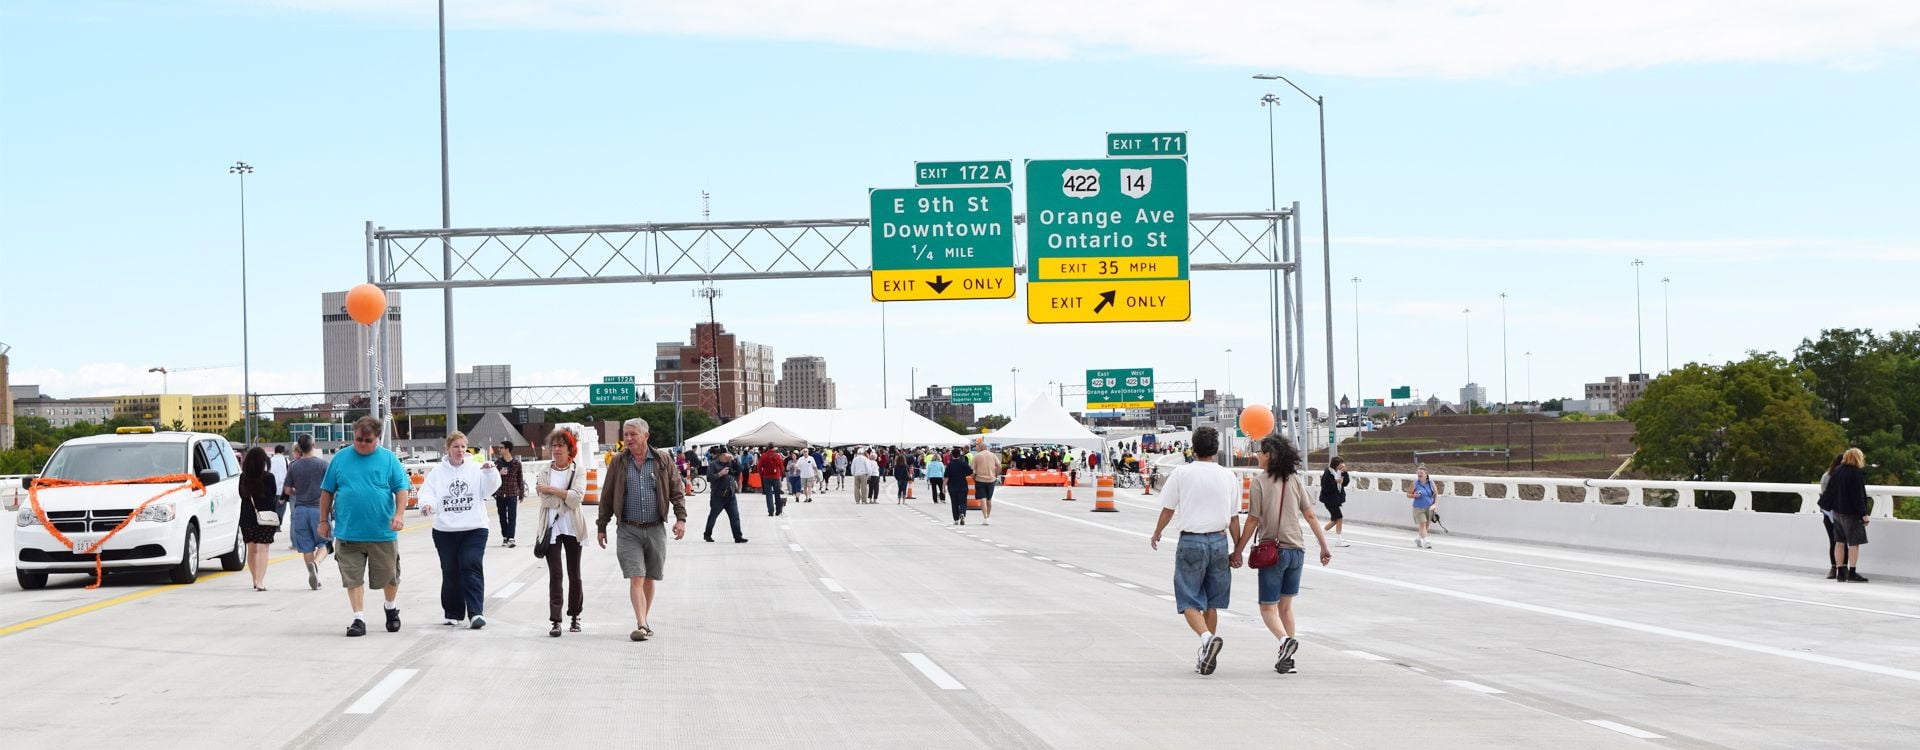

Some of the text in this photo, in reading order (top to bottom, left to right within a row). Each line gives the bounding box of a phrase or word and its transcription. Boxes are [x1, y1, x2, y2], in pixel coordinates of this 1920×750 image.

[1113, 137, 1182, 151] EXIT 171
[921, 165, 1006, 180] EXIT 172 A
[1064, 174, 1146, 192] 422 14
[894, 197, 989, 214] E 9th St
[1040, 208, 1175, 228] Orange Ave
[883, 222, 1001, 238] Downtown
[1048, 232, 1167, 249] Ontario St
[945, 247, 974, 257] MILE
[1061, 261, 1156, 274] EXIT 35 MPH
[884, 278, 1003, 292] EXIT ONLY
[1052, 296, 1167, 309] EXIT ONLY
[443, 497, 473, 505] KOPP
